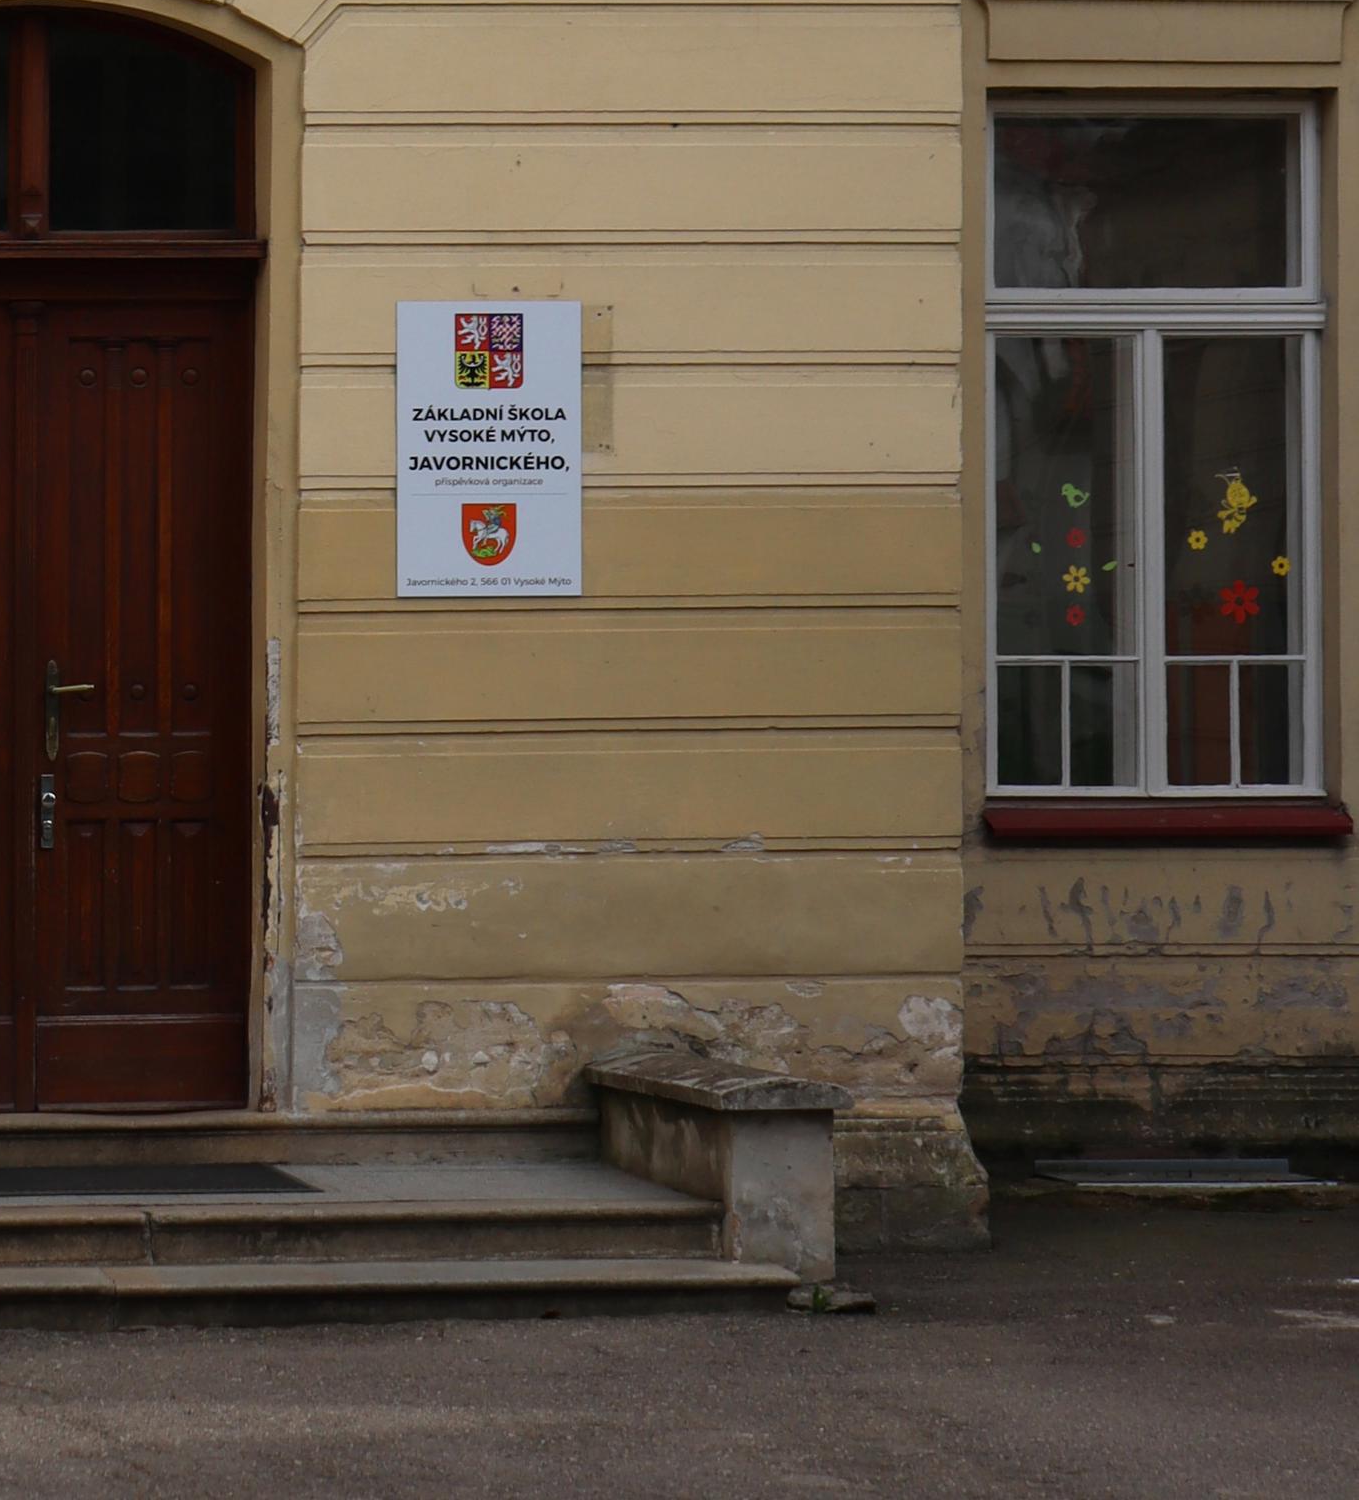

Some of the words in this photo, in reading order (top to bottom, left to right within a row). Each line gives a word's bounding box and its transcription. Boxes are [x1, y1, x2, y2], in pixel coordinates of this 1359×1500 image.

[412, 405, 503, 421] ZÁKLADNÍ
[508, 404, 567, 421] ŠKOLA
[424, 426, 496, 443] VYSOKÉ
[501, 426, 555, 444] MÝTO,
[409, 452, 570, 472] JAVORNICKÉHO,
[492, 477, 543, 486] organizace
[407, 577, 468, 587] Javornického
[481, 578, 498, 586] 566
[501, 577, 511, 586] 01
[514, 577, 545, 587] Vysoké
[549, 577, 572, 587] Mýto
